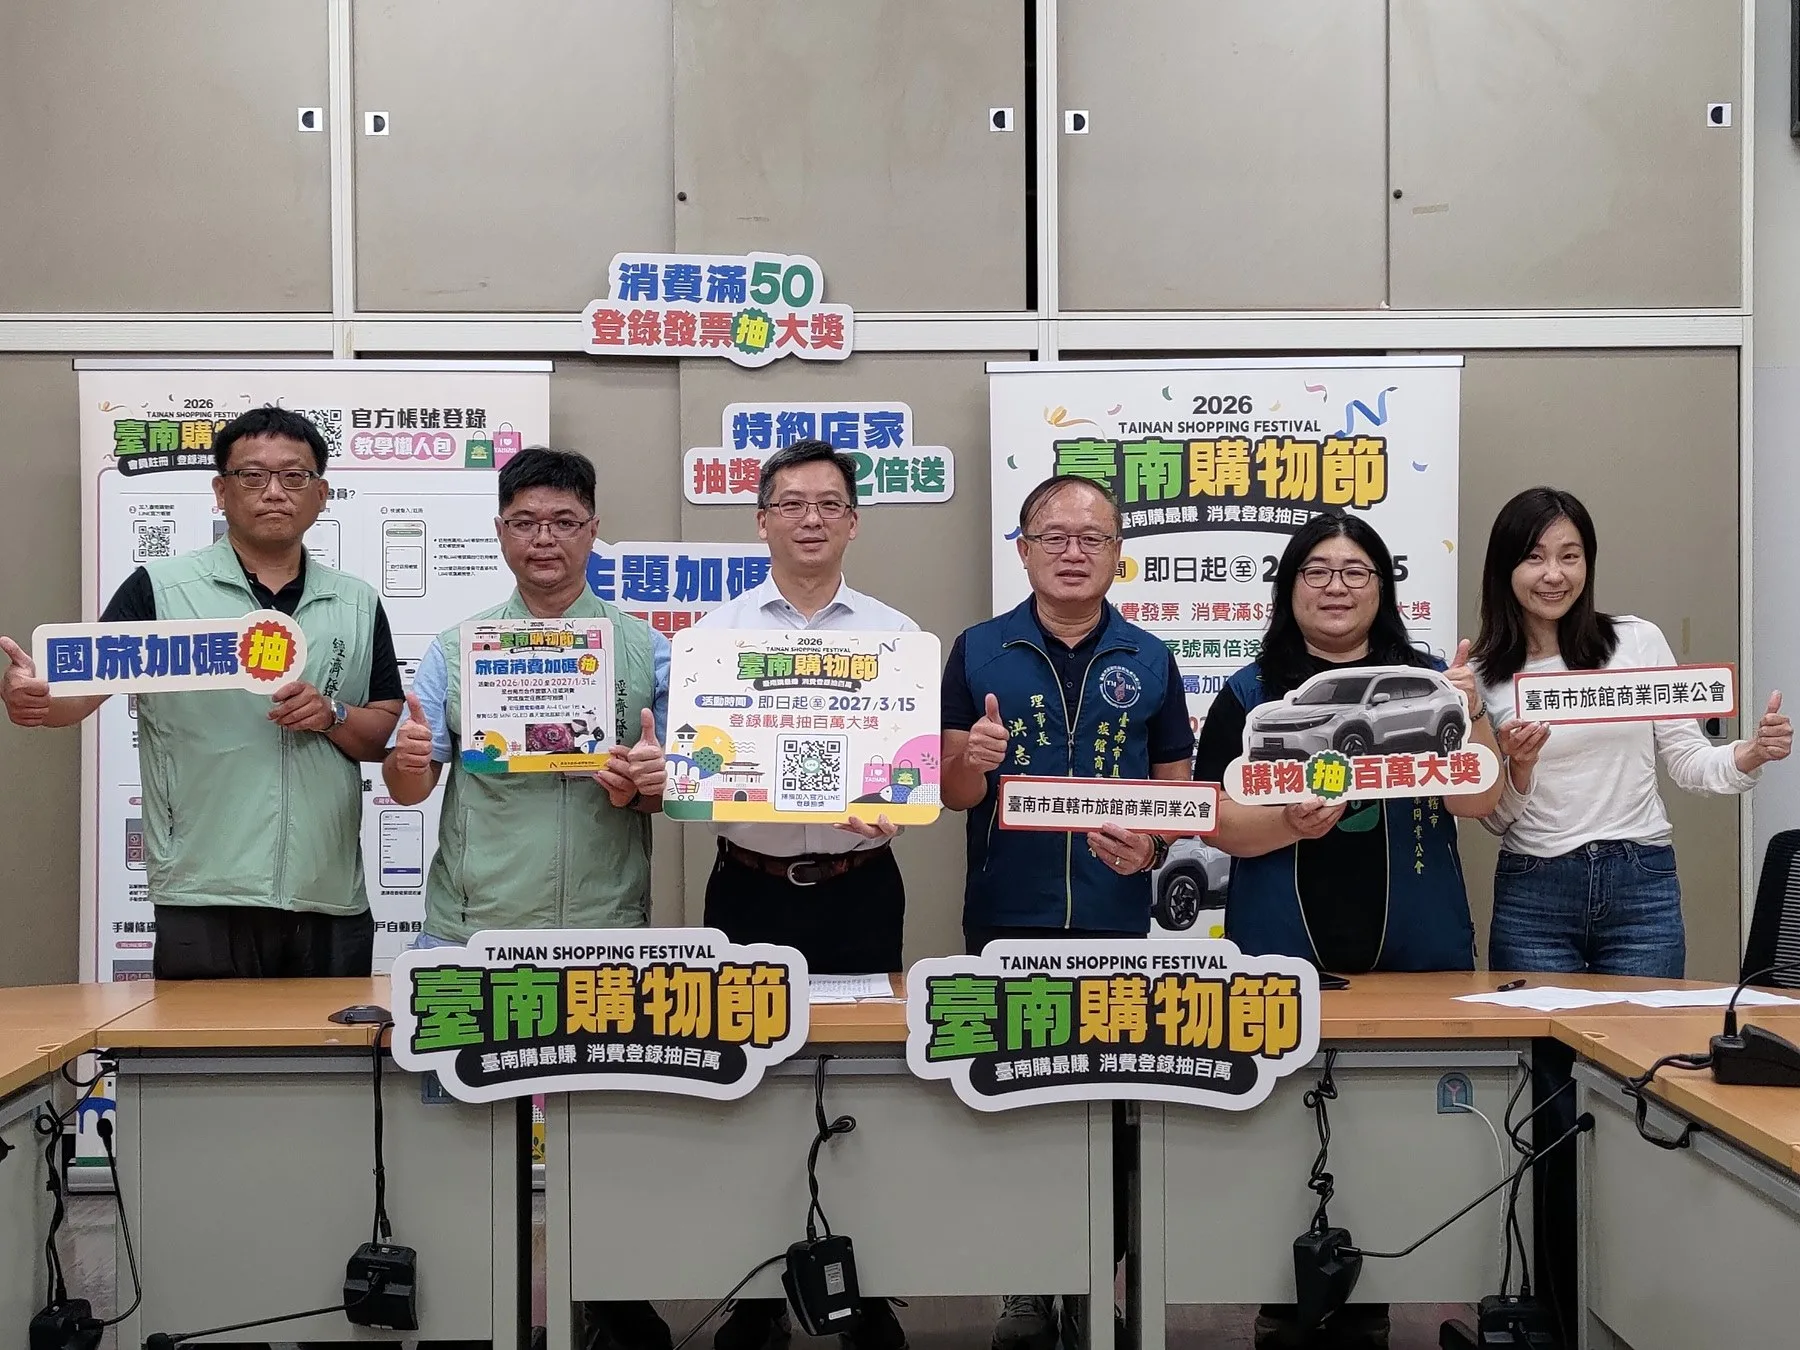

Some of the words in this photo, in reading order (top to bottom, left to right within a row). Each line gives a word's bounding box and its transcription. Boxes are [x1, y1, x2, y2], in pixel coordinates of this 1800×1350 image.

[617, 261, 815, 308] 消費滿50
[591, 308, 845, 351] 登錄發票抽大獎
[183, 399, 214, 409] 2026
[351, 407, 487, 429] 官方帳號登錄
[1192, 395, 1253, 415] 2026
[114, 419, 227, 457] 臺南購
[732, 410, 905, 450] 特約店家
[1118, 421, 1175, 434] TAINAN
[1178, 421, 1251, 434] SHOPPING
[1254, 421, 1321, 434] FESTIVAL
[354, 436, 453, 456] 教學懶人包
[1054, 436, 1389, 509] 臺南購物節
[1112, 602, 1180, 622] 費發票
[46, 629, 288, 682] 國旅加碼抽
[797, 638, 823, 646] 2026
[475, 656, 597, 676] 旅宿消費加碼抽
[737, 652, 879, 681] 臺南購物節
[701, 696, 747, 707] 活動時間
[1525, 681, 1726, 711] 臺南市旅館商業同業公會
[728, 713, 879, 730] 登錄載具抽百萬大獎
[1030, 694, 1052, 746] 理事長
[1008, 718, 1031, 775] 洪志
[1094, 721, 1111, 778] 旅館商
[1241, 752, 1482, 796] 購物抽百萬大獎
[1008, 794, 1212, 819] 臺南市直轄市旅館商業同業公會
[485, 945, 550, 961] TAINAN
[552, 944, 634, 960] SHOPPING
[639, 944, 715, 960] FESTIVAL
[1000, 955, 1061, 970] TAINAN
[1066, 955, 1147, 970] SHOPPING
[1152, 955, 1228, 970] FESTIVAL
[411, 964, 790, 1054] 臺南購物節
[926, 973, 1301, 1062] 臺南購物節
[481, 1046, 577, 1073] 臺南購最賺
[586, 1043, 722, 1070] 消費登錄抽百萬
[995, 1055, 1090, 1082] 臺南購最賺
[1099, 1053, 1232, 1080] 消費登錄抽百萬
